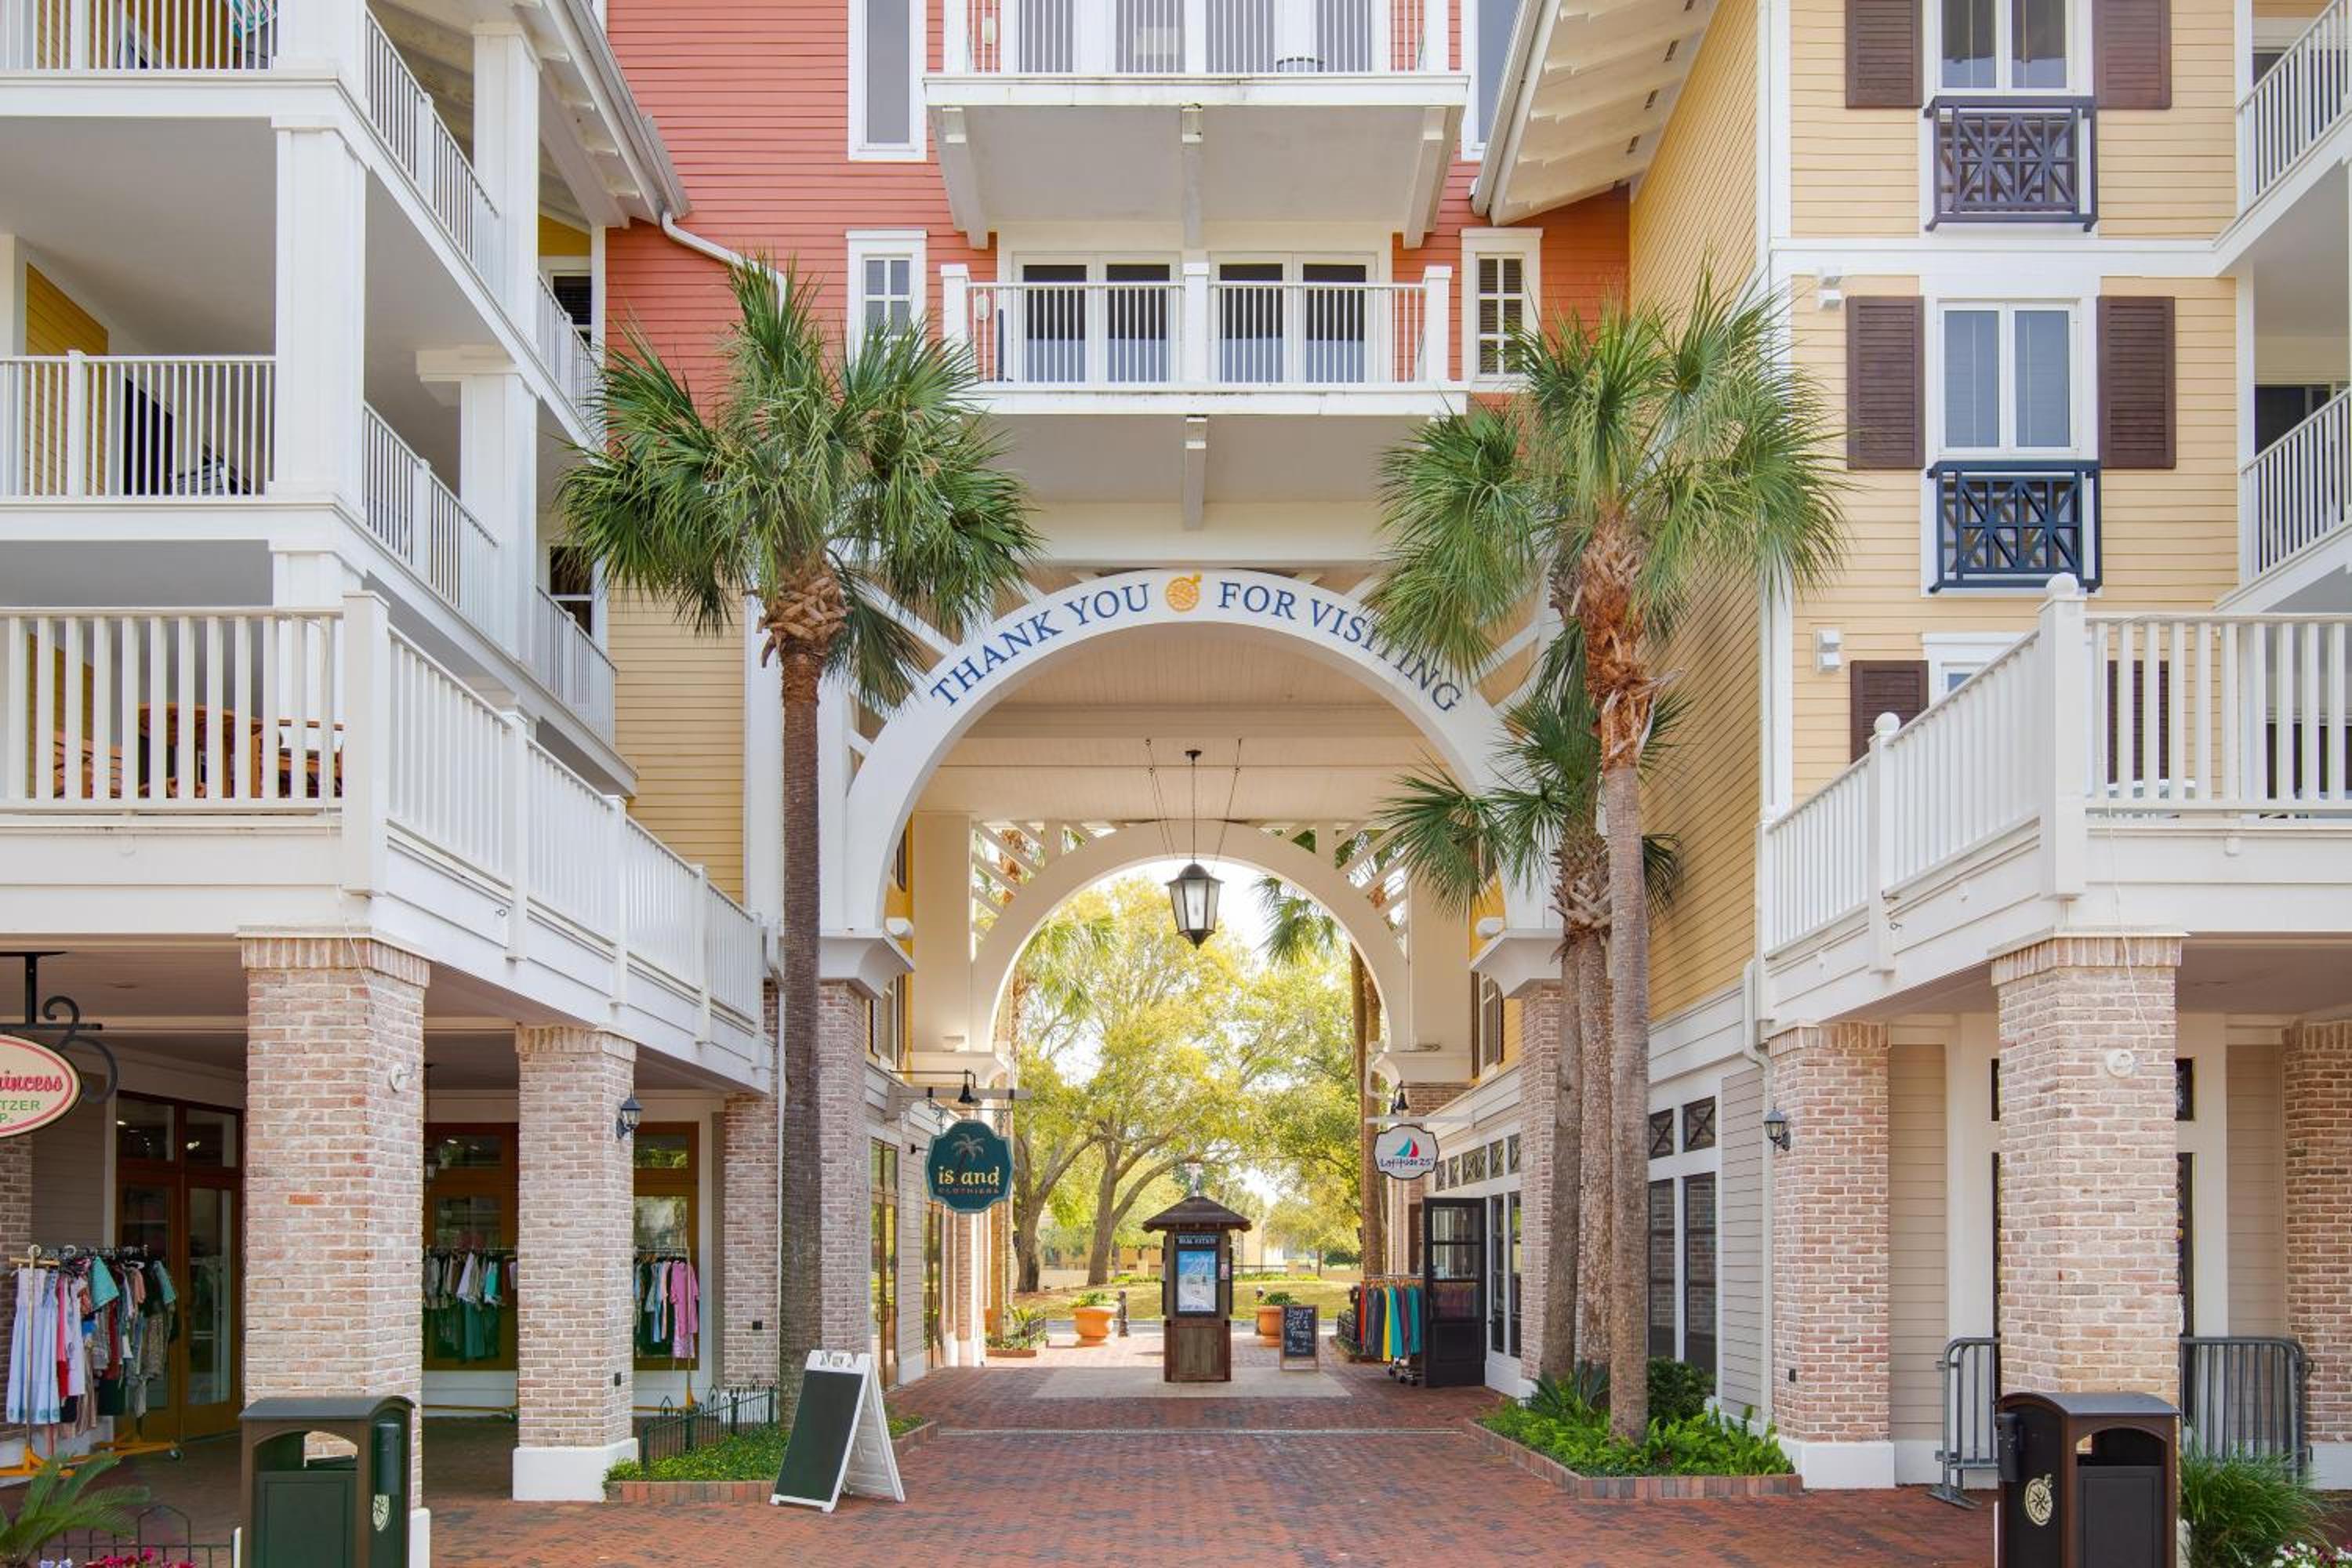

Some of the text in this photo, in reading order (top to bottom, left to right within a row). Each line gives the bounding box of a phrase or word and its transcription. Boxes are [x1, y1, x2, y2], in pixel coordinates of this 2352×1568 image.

[930, 612, 1062, 708] THANK
[1065, 583, 1150, 627] YOU
[1218, 581, 1297, 620] FOR
